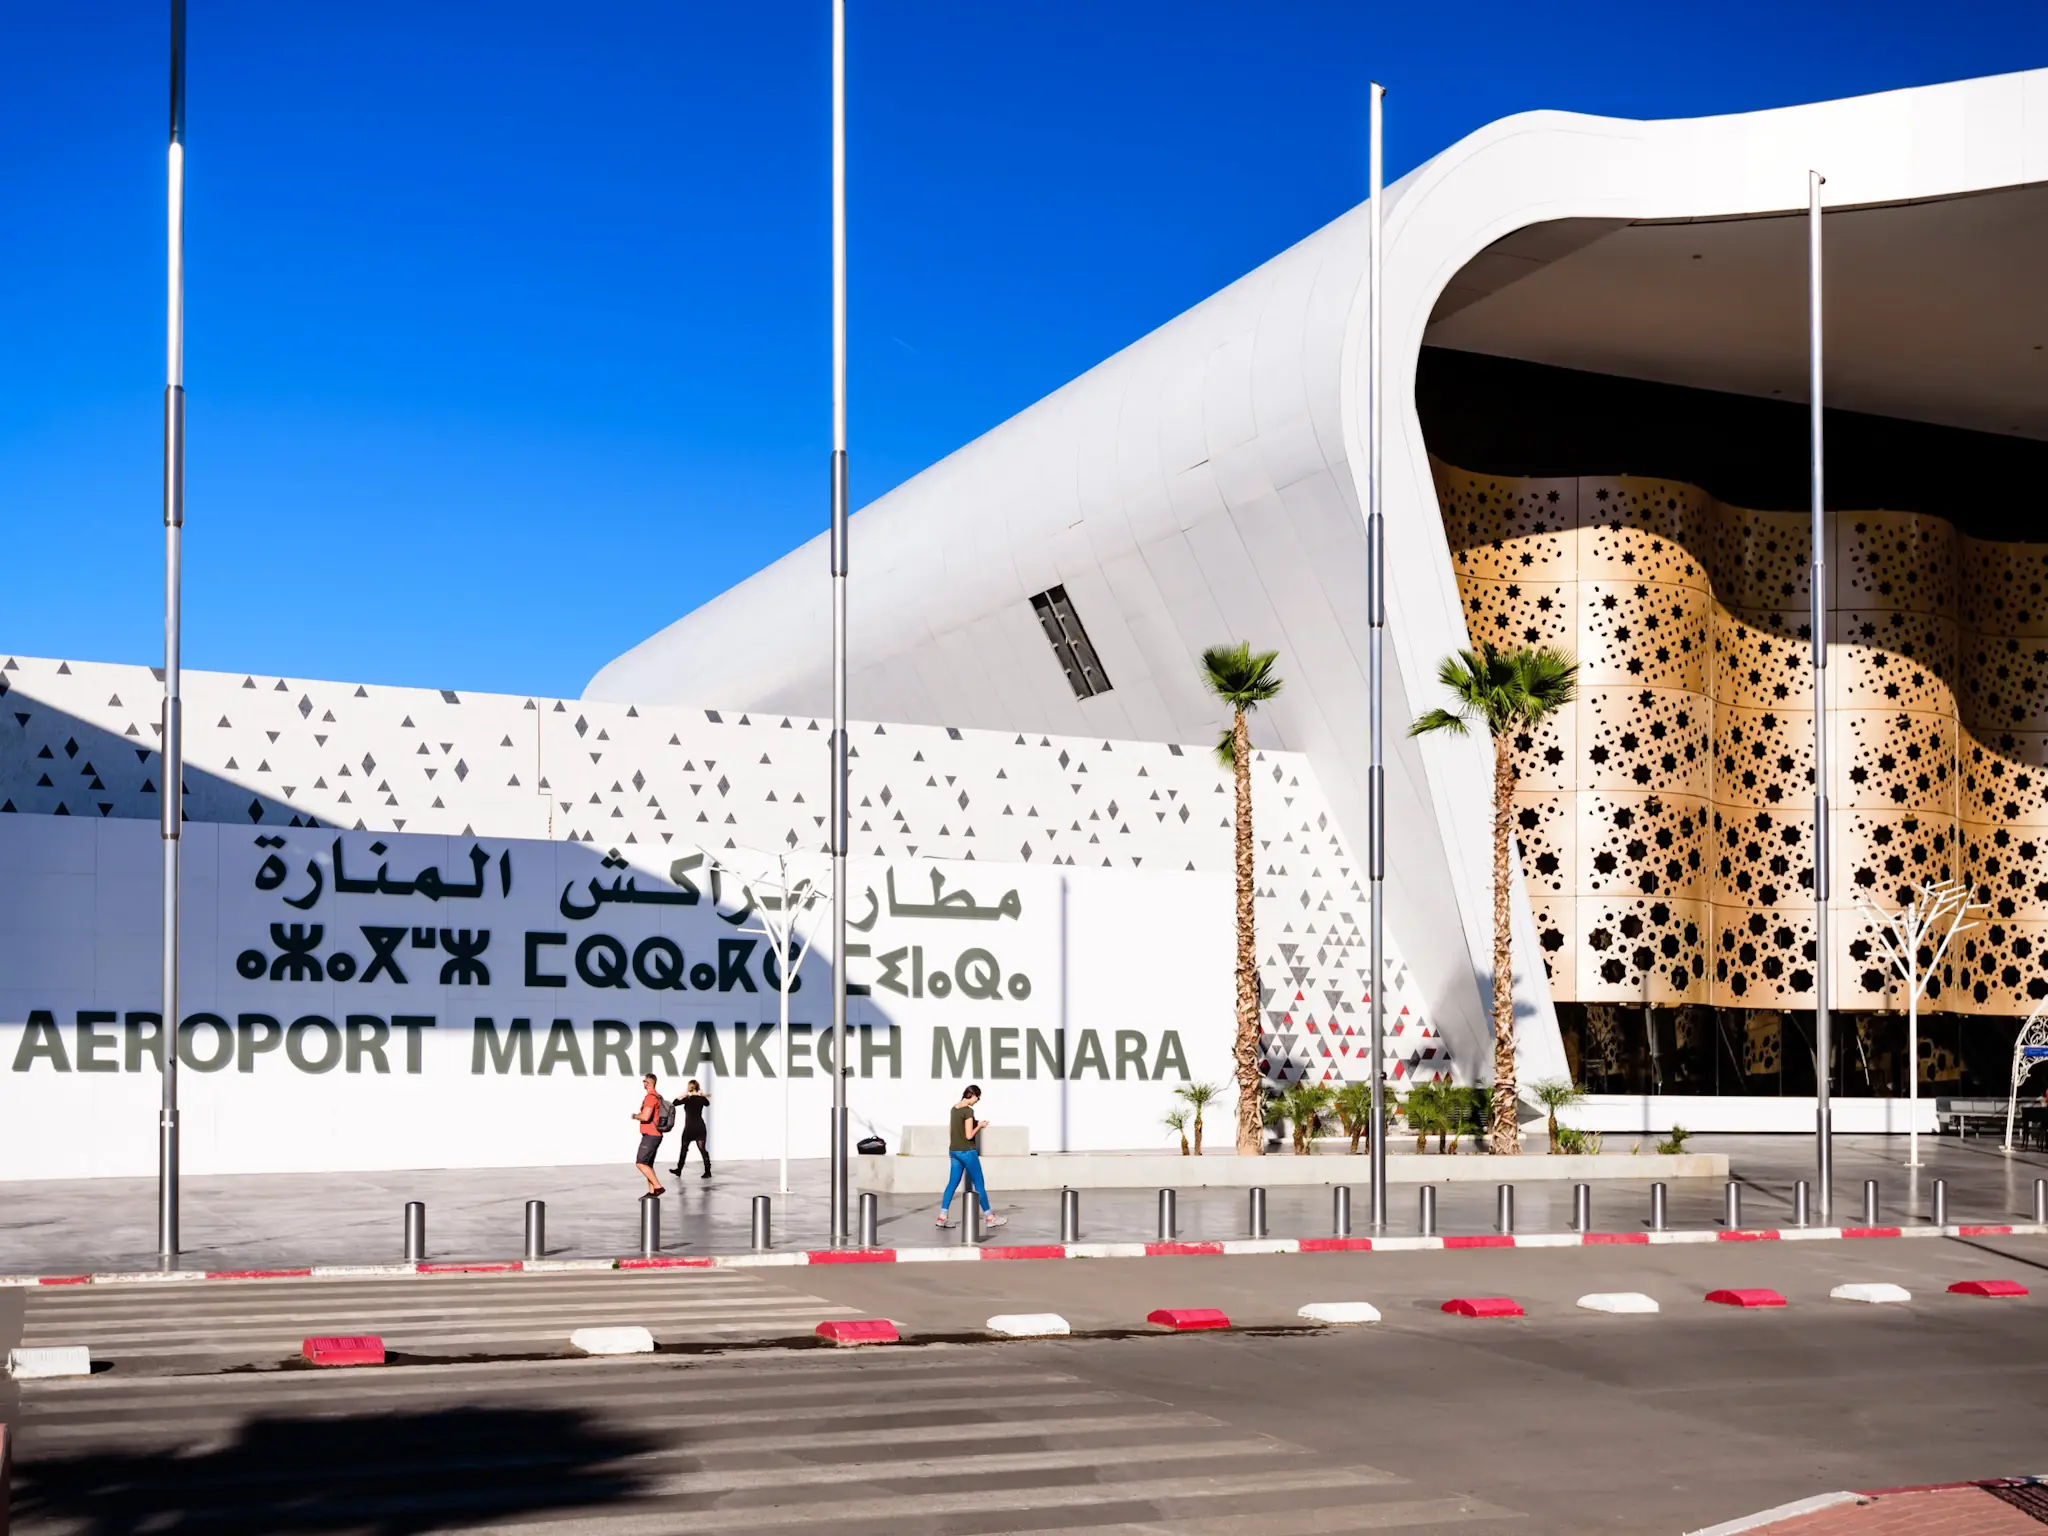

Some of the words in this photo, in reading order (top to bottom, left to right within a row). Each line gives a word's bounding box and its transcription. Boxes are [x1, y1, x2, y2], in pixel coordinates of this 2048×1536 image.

[253, 834, 512, 910] المنارة
[846, 865, 1022, 932] مطار
[12, 1009, 437, 1074] AEROPORT
[471, 1016, 902, 1080] MARRAKECH
[930, 1025, 1192, 1081] MENARA
